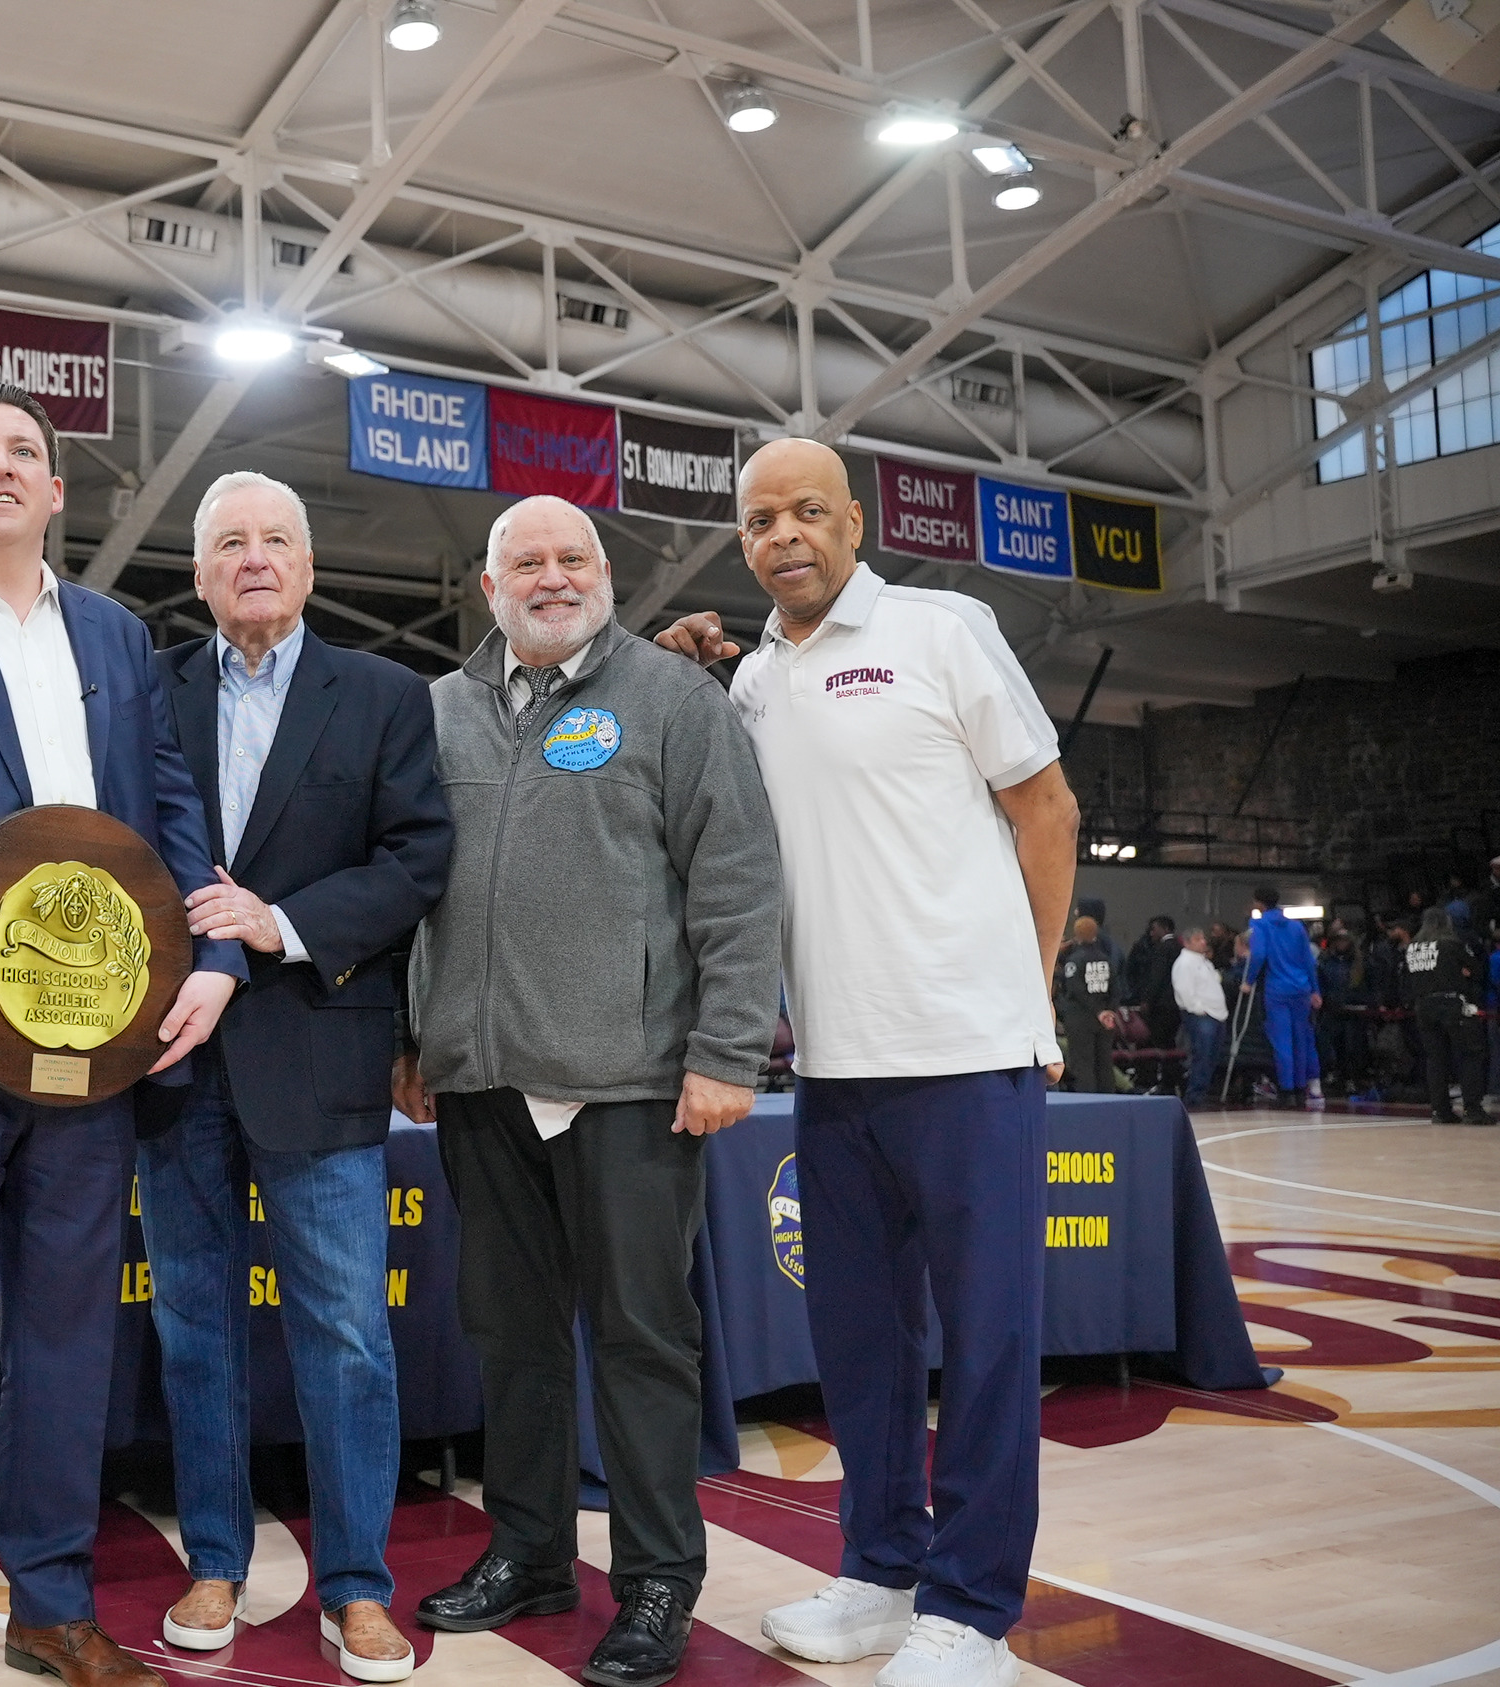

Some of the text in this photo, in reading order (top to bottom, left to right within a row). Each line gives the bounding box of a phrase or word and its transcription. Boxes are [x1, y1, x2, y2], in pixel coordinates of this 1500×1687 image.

[370, 383, 466, 429] RHODE
[367, 426, 471, 473] ISLAND
[495, 422, 612, 476] RICHMOND
[623, 444, 733, 495] ST. BONAVENTURE
[898, 474, 956, 511] SAINT
[995, 493, 1053, 529] SAINT
[891, 513, 969, 549] JOSEPH
[998, 527, 1057, 564] LOUIS
[1091, 523, 1143, 564] VCU
[825, 668, 894, 692] STEPINAC
[836, 686, 881, 699] BASKETBALL
[546, 740, 597, 757] HIGH SCHOOLS
[557, 750, 609, 767] ASSOCIATION
[562, 746, 598, 758] ATHLETIC
[15, 921, 99, 962] CATHOLIC
[2, 967, 108, 990] HIGH SCHOOLS
[38, 991, 100, 1009] ATHLETIC
[25, 1008, 114, 1028] ASSOCIATION
[1046, 1151, 1114, 1184] CHOOLS
[775, 1231, 793, 1244] HIGH
[1045, 1215, 1109, 1248] IATION
